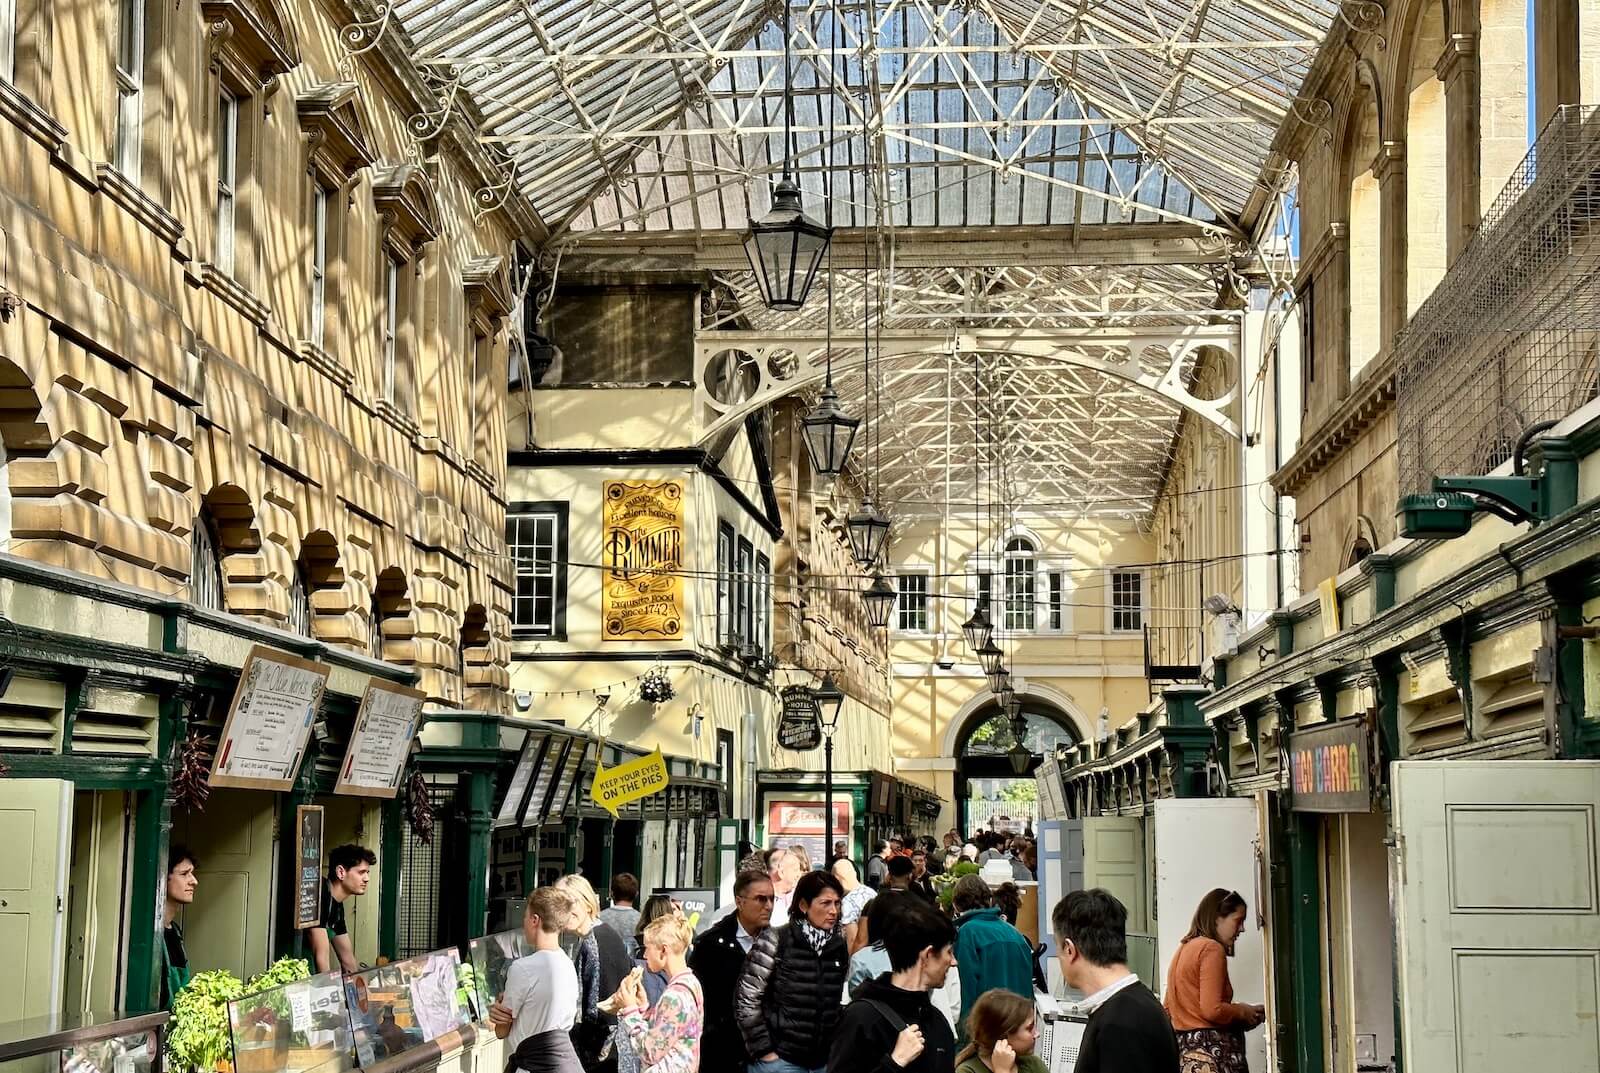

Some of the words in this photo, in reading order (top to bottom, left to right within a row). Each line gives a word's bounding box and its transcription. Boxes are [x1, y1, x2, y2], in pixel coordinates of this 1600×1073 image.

[606, 529, 682, 579] RUMMER
[611, 596, 649, 609] Exquisite
[651, 592, 674, 604] Food
[638, 581, 649, 593] &
[621, 607, 643, 618] Since
[645, 603, 668, 616] 1742
[600, 778, 618, 790] KEEP
[619, 770, 640, 783] YOUR
[641, 763, 660, 776] EYES
[1315, 743, 1361, 793] BARRA
[603, 788, 618, 800] ON
[619, 780, 640, 794] THE
[641, 772, 663, 787] PIES
